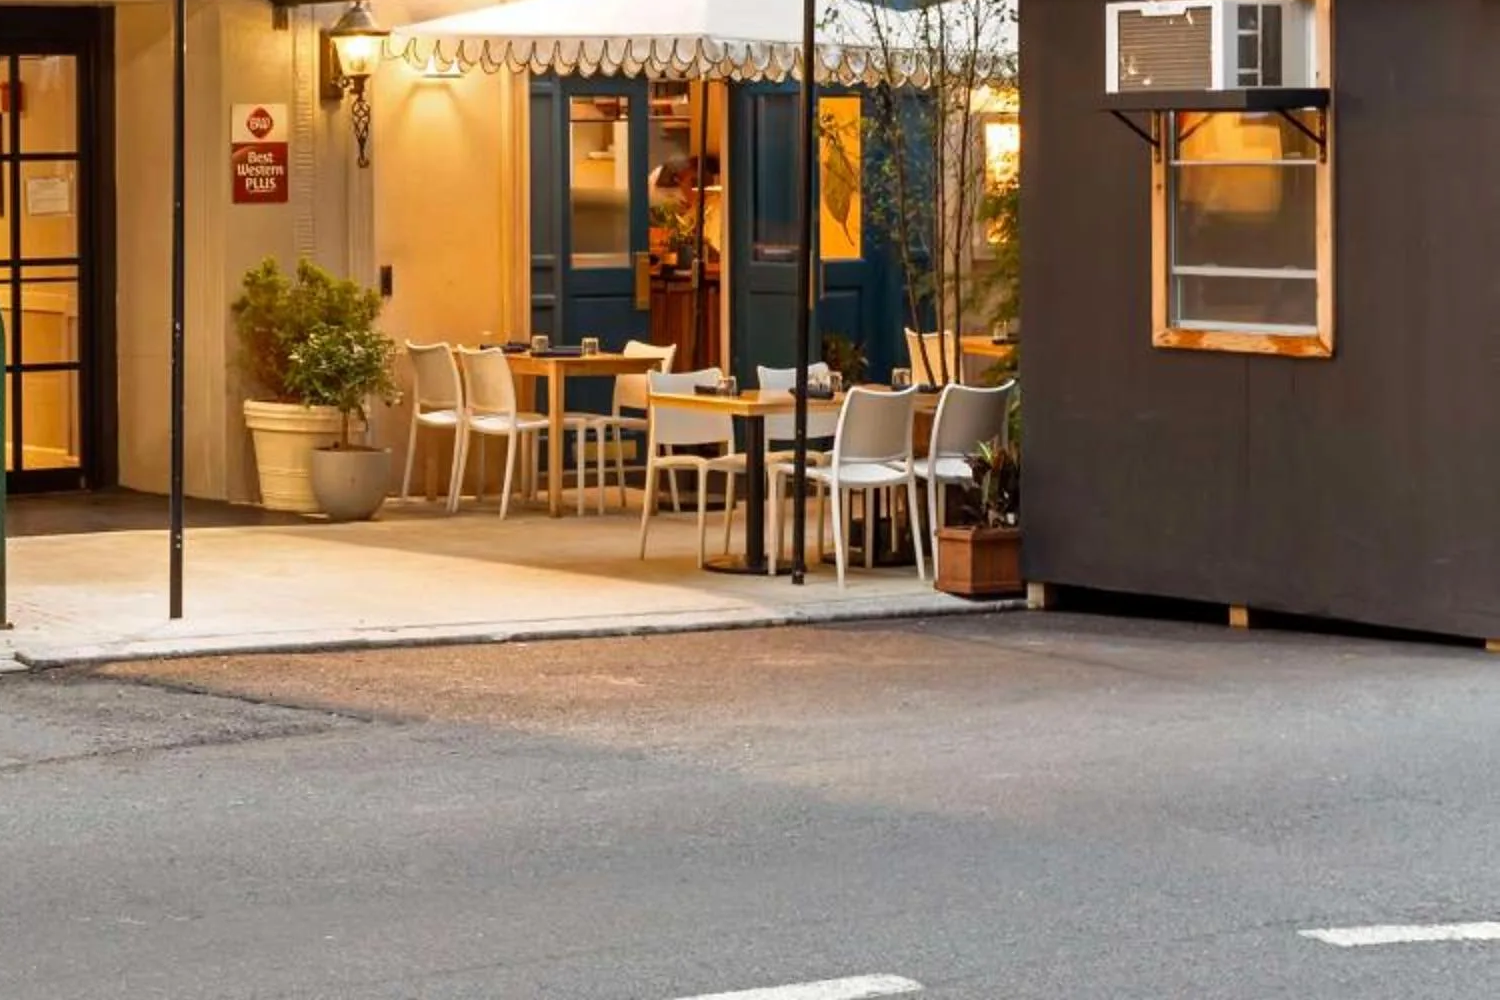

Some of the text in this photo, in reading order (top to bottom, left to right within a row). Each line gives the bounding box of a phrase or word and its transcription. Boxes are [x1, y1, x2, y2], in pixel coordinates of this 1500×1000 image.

[247, 152, 274, 163] Best
[237, 164, 285, 176] Western
[245, 177, 276, 190] PLUS
